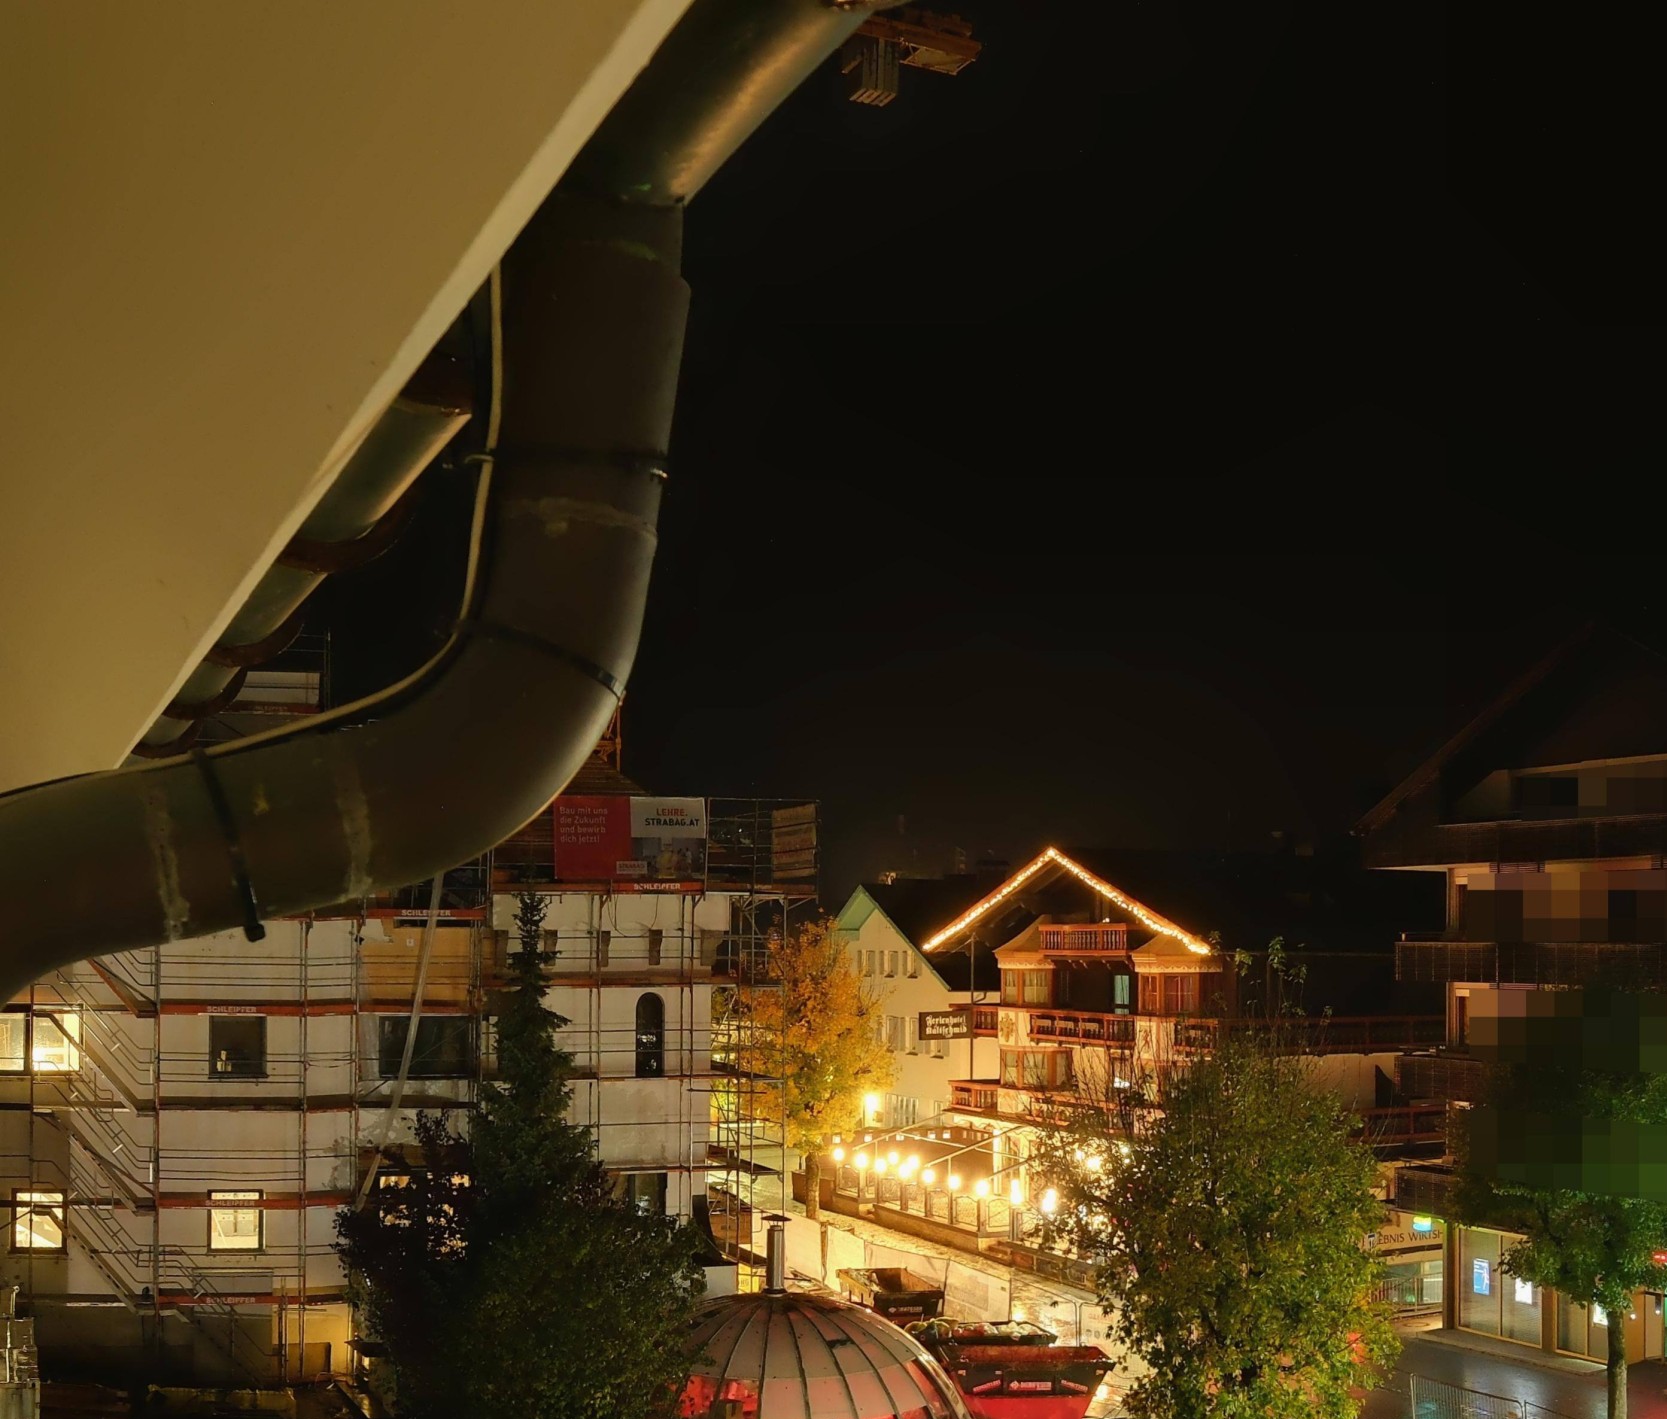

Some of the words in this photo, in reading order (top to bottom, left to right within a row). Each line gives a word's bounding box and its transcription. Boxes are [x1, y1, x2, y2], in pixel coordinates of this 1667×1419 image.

[560, 806, 575, 815] Bau
[578, 806, 591, 815] mit
[656, 808, 688, 817] LEHRE.
[560, 816, 572, 824] die
[574, 816, 606, 824] Zukunft
[645, 818, 700, 827] STRABAG.AT
[560, 825, 575, 833] und
[578, 825, 606, 833] bewirb
[560, 834, 577, 842] dich
